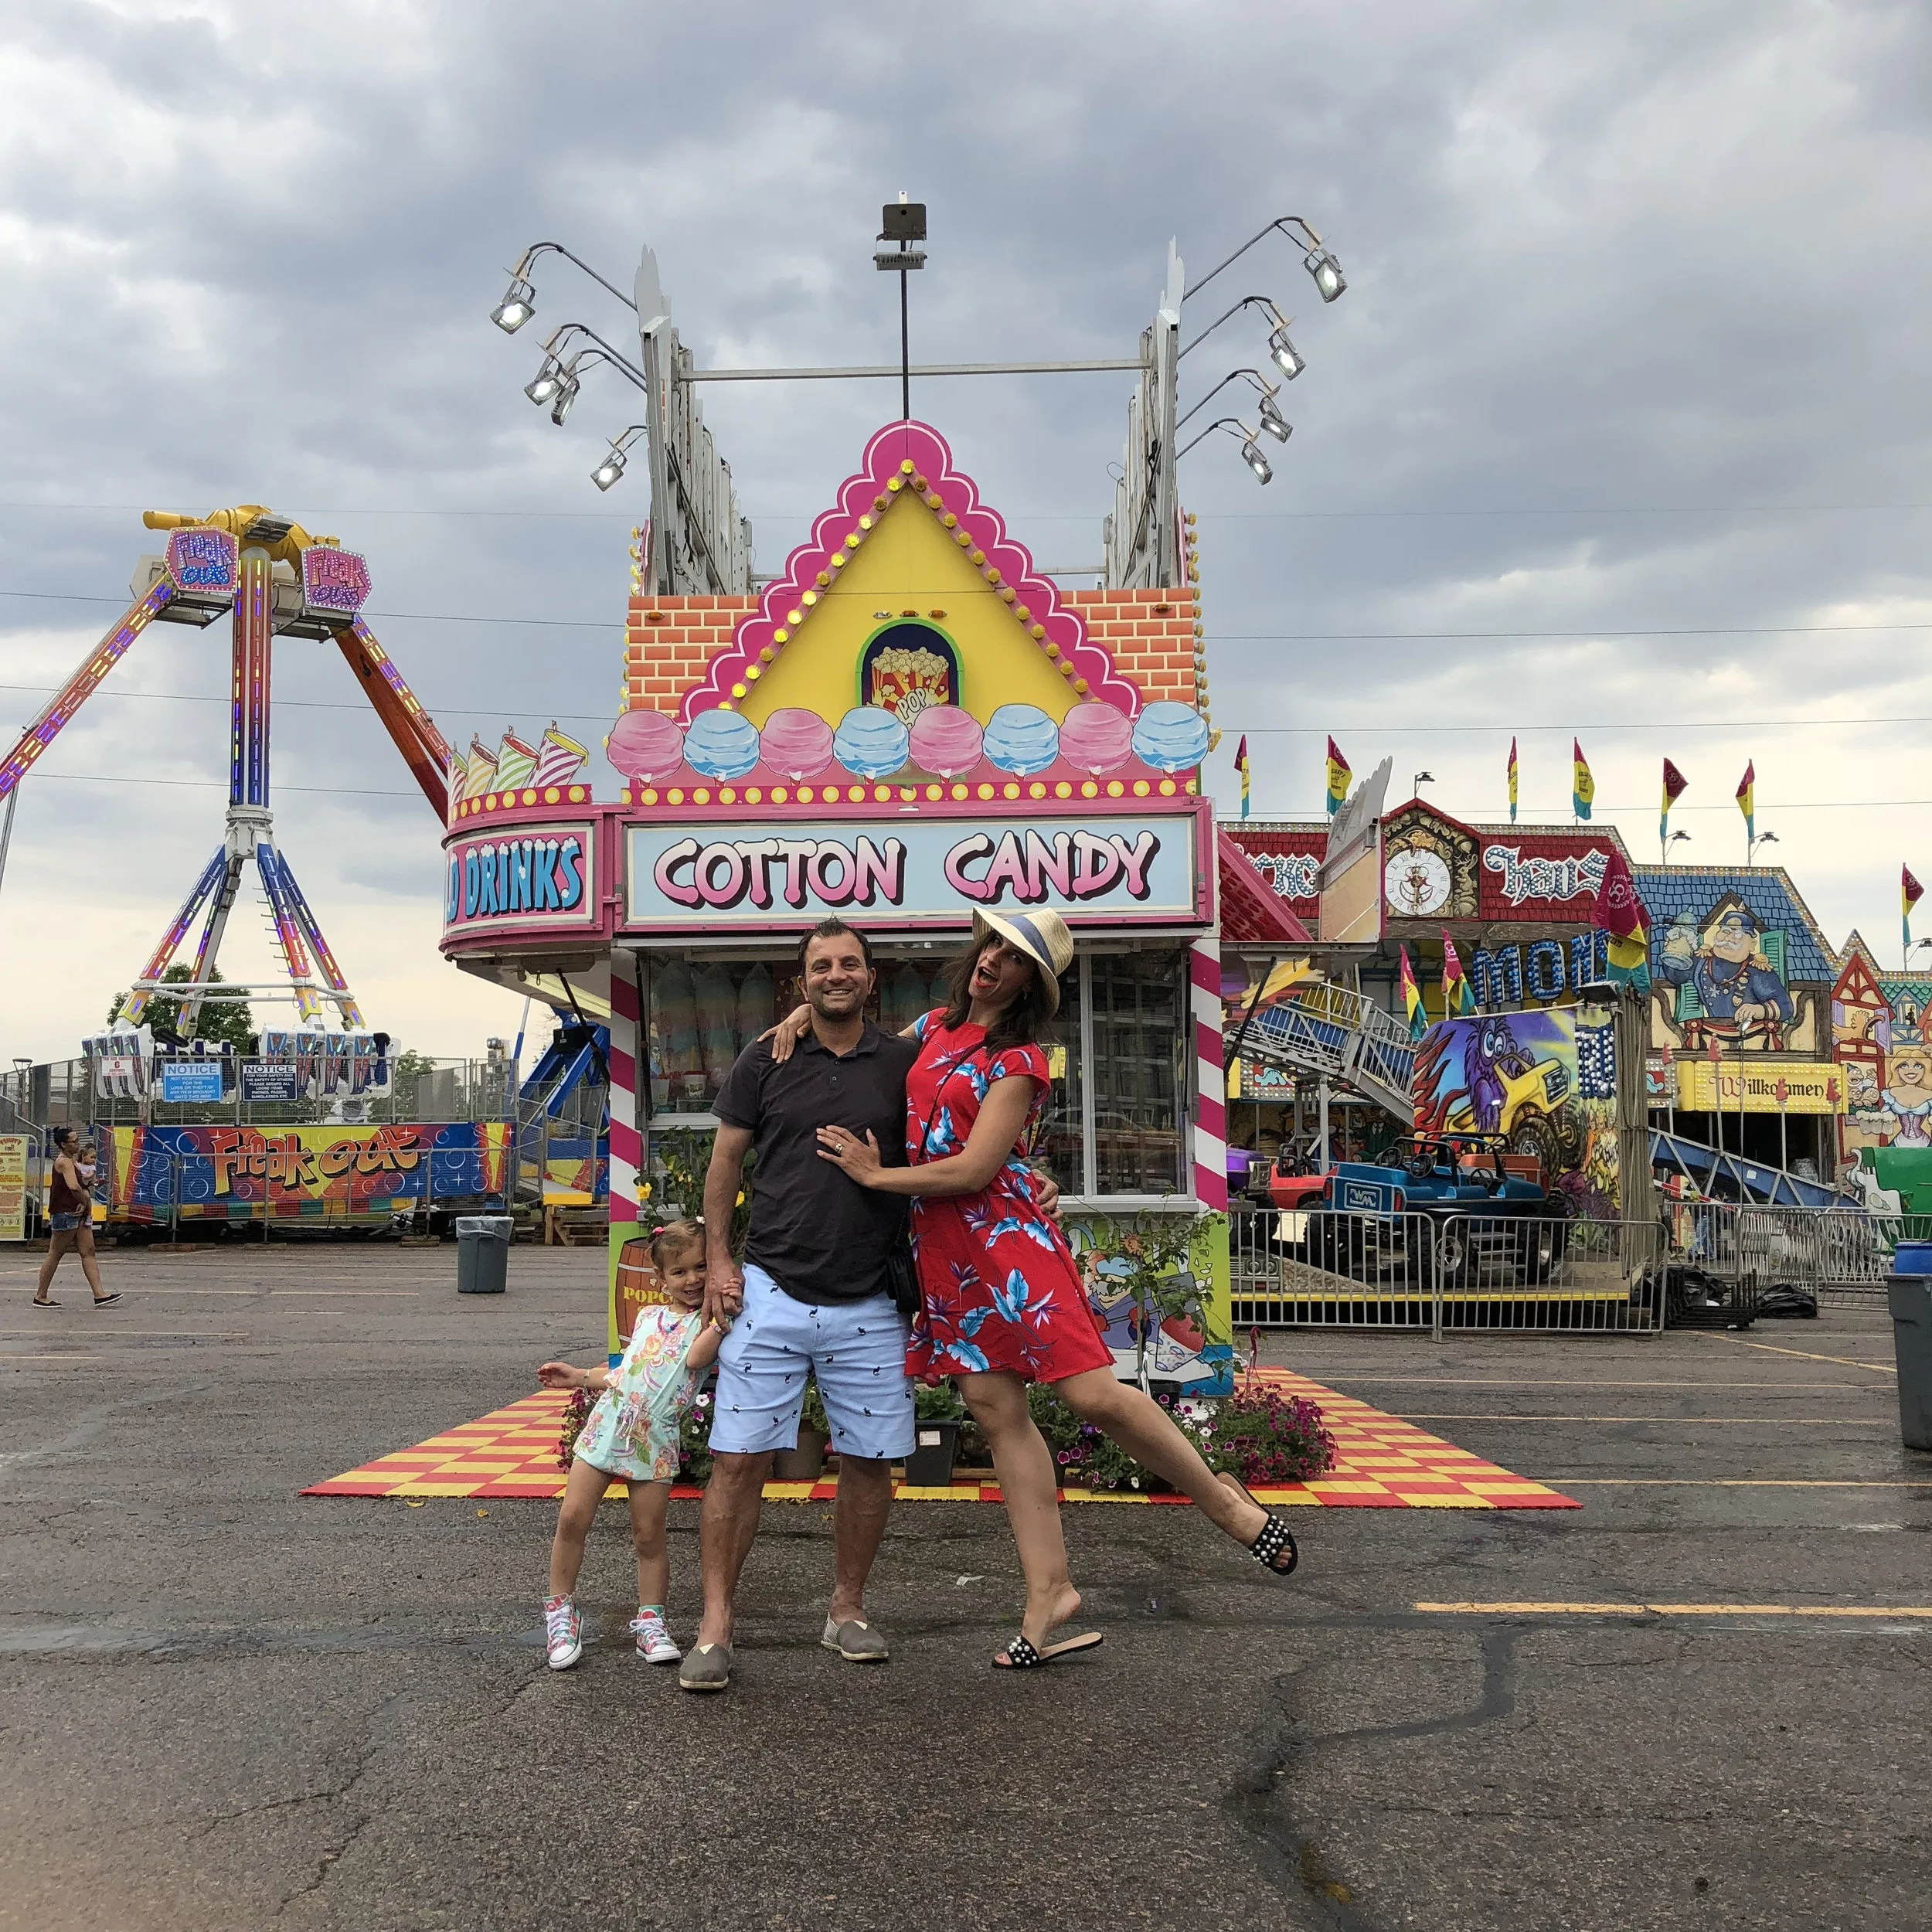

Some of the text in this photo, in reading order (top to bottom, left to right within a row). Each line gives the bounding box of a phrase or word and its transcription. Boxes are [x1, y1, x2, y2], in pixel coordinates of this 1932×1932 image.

[174, 532, 235, 570] Freak
[311, 550, 367, 590] Freak
[896, 686, 927, 720] POP
[465, 835, 584, 920] DRINKS
[654, 829, 1161, 910] COTTON CANDY
[168, 1065, 217, 1074] NOTICE
[210, 1128, 422, 1196] Freak out
[623, 1286, 674, 1304] POPC
